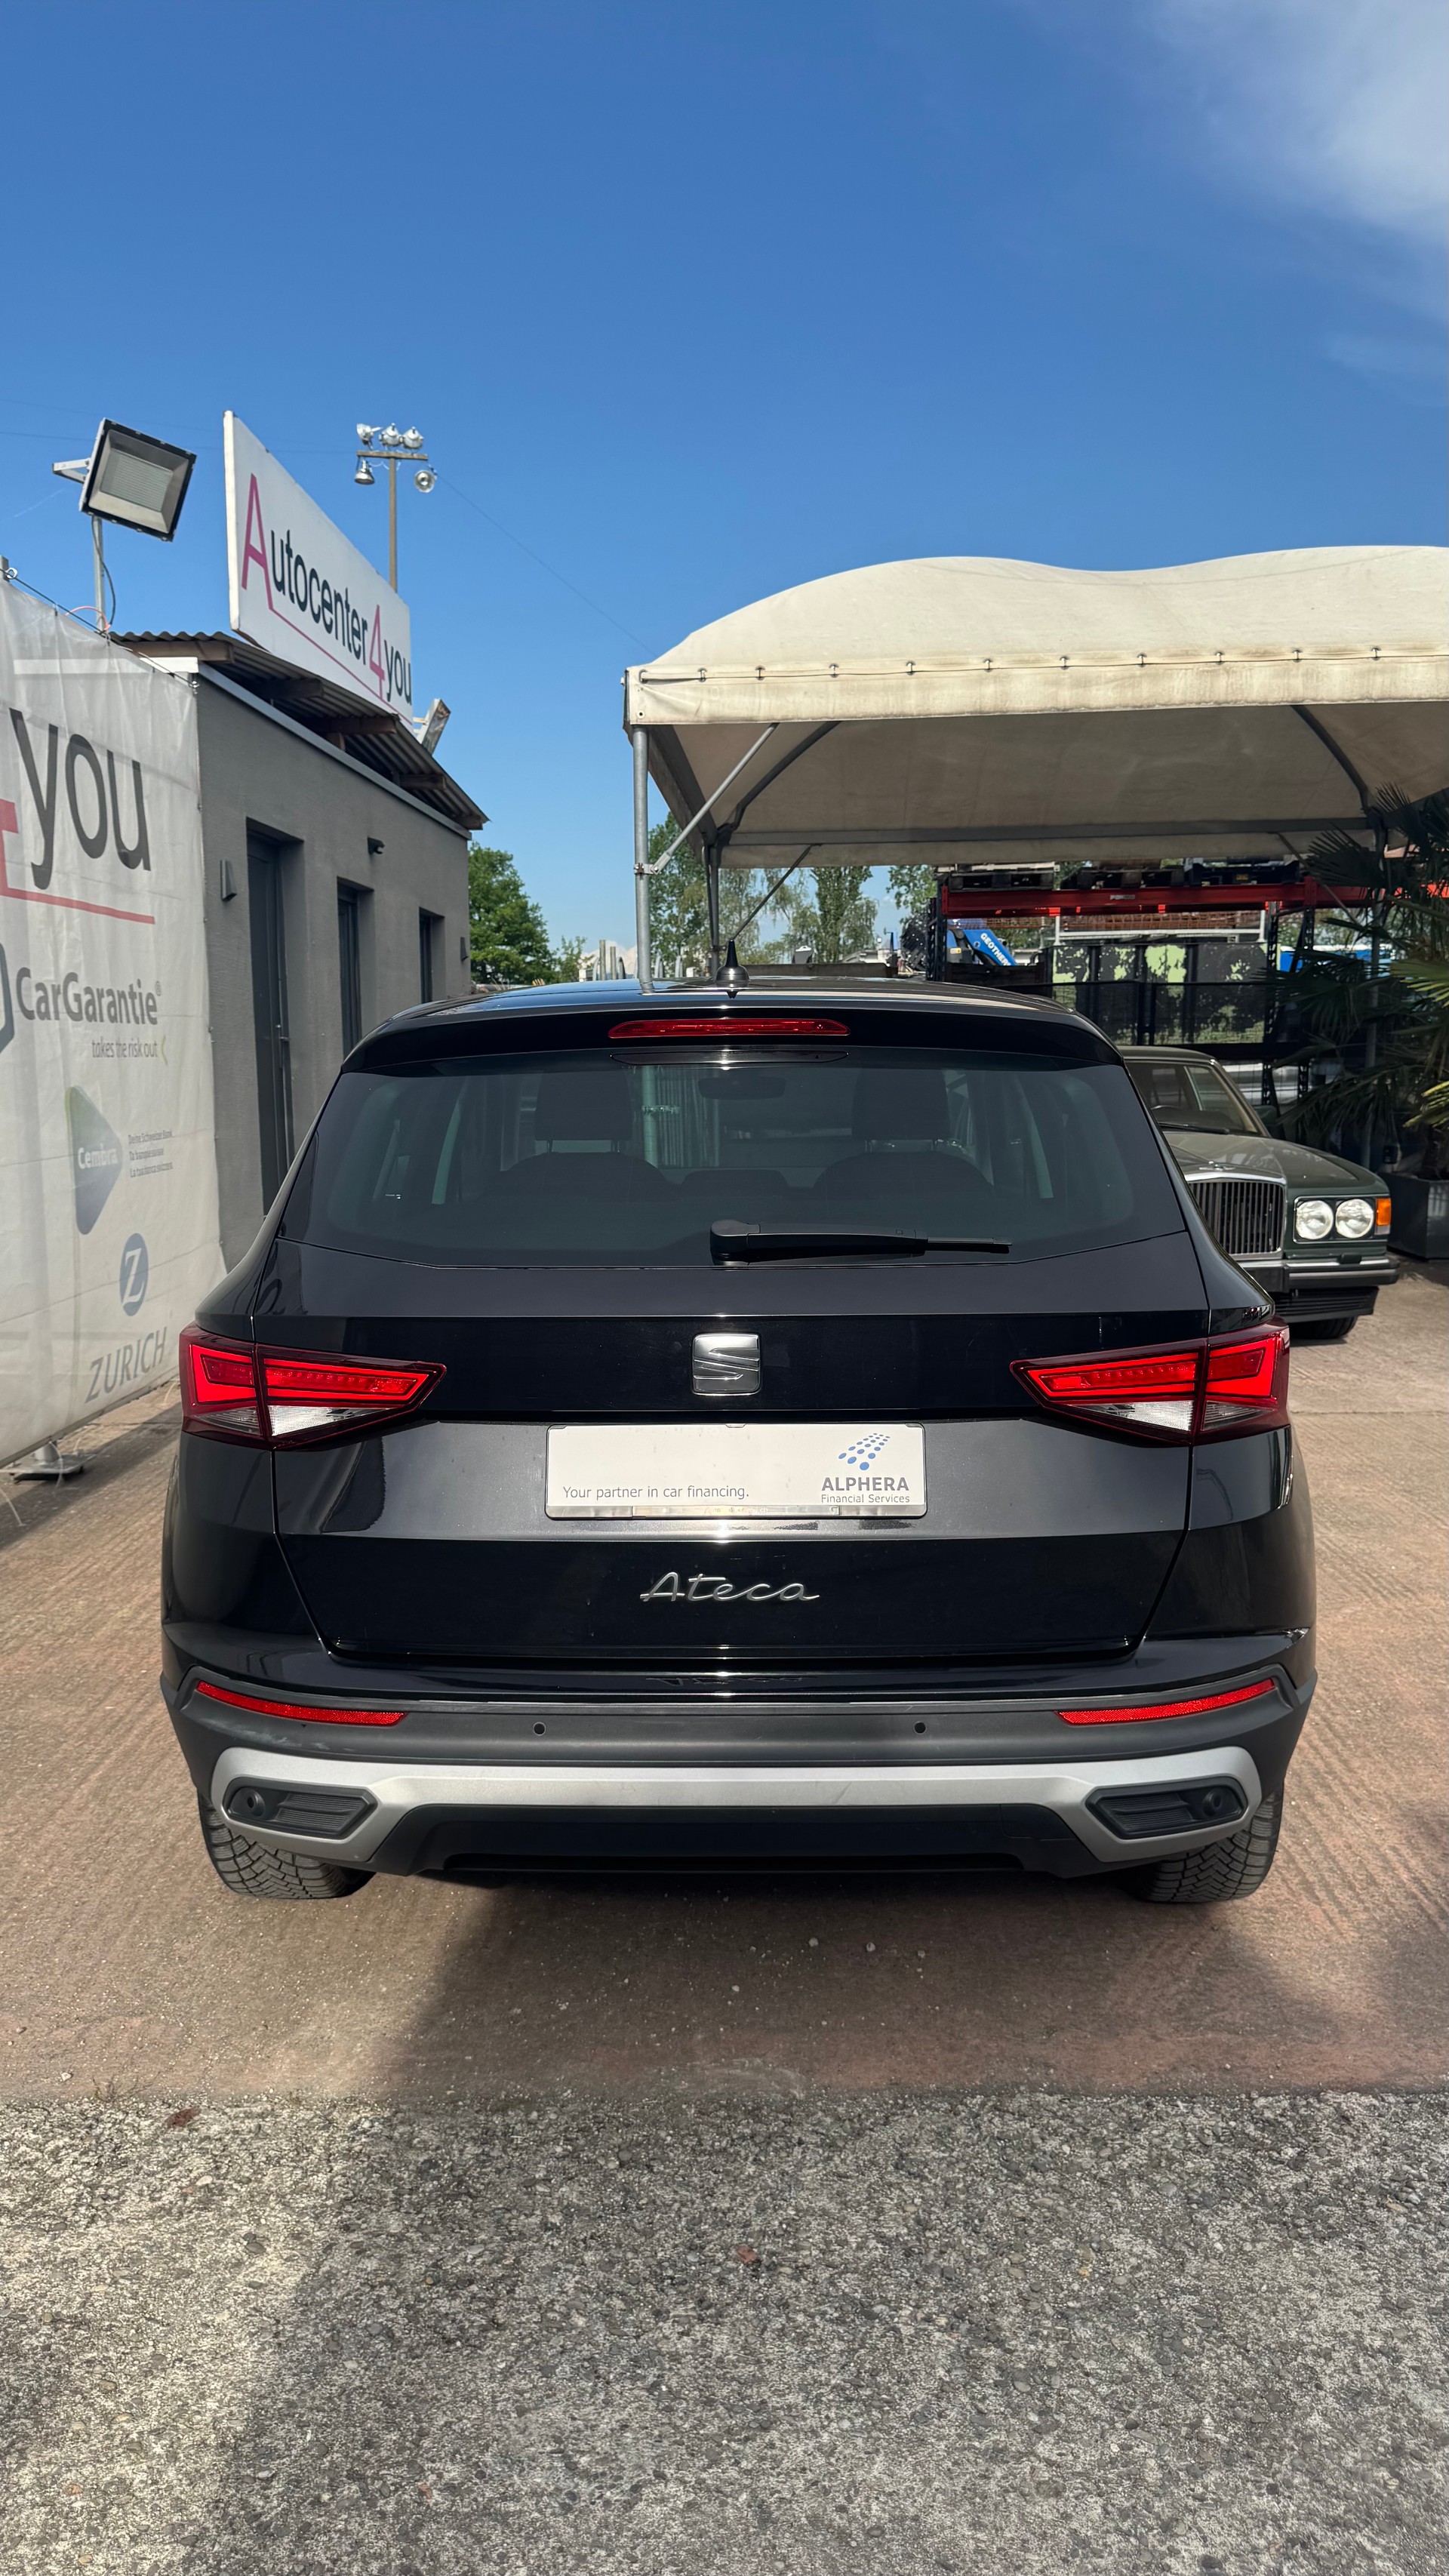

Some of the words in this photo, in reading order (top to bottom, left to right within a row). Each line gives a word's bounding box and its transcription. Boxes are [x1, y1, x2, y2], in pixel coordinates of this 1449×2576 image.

[0, 707, 151, 891] you
[91, 1036, 114, 1057] takes
[128, 1037, 143, 1057] risk
[144, 1041, 158, 1057] out
[78, 1143, 118, 1169] Cembra
[85, 1326, 168, 1404] ZURICH
[563, 1486, 592, 1498] Your
[596, 1486, 642, 1500] partner
[648, 1485, 658, 1497] in
[663, 1488, 683, 1497] car
[688, 1485, 749, 1500] financing.
[821, 1476, 909, 1491] ALPHERA
[821, 1494, 864, 1503] Financial
[868, 1494, 910, 1503] Services
[640, 1571, 820, 1602] Ateca
